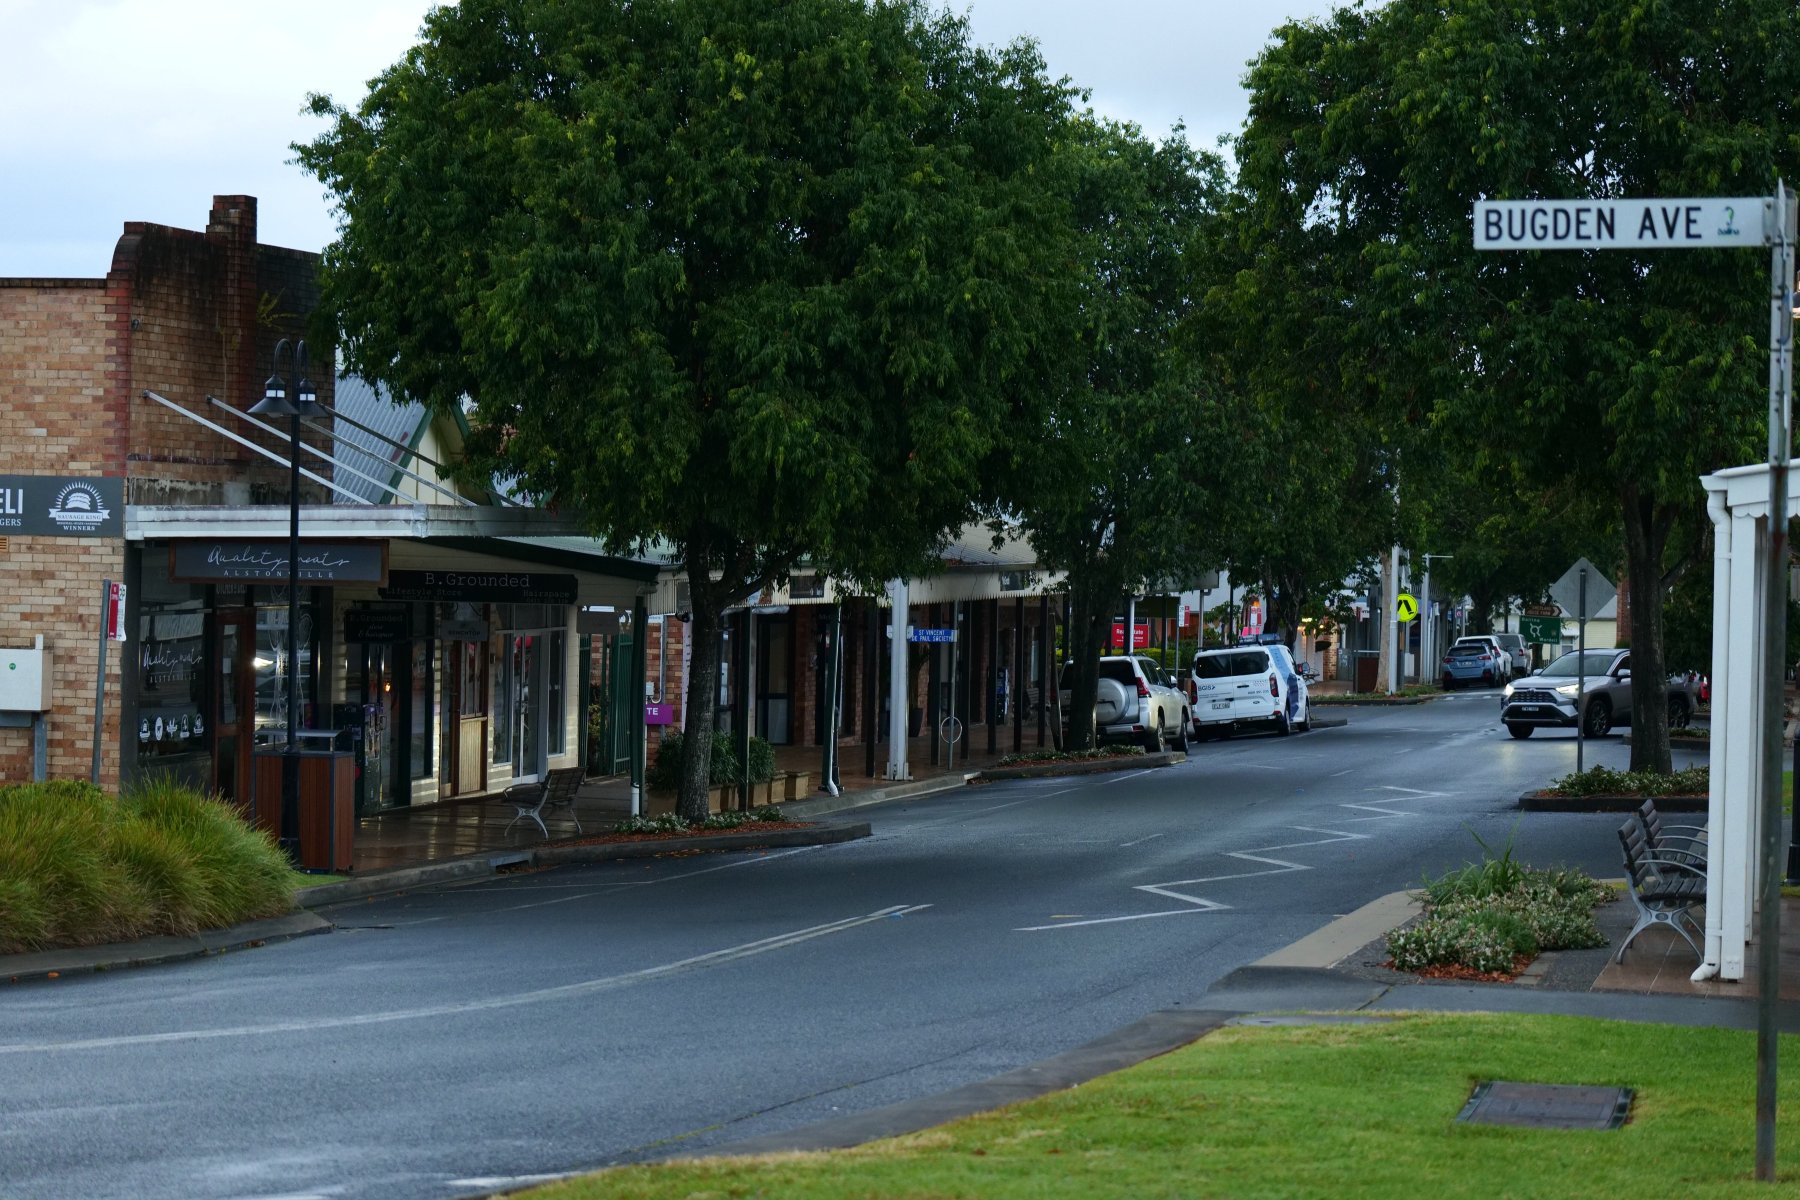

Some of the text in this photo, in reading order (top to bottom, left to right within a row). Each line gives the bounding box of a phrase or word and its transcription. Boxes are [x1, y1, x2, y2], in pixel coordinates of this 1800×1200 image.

[1485, 206, 1702, 241] BUGDEN AVE
[207, 545, 290, 572] Quality
[223, 569, 335, 579] ALSTONILLE
[425, 572, 530, 588] B.Grounded
